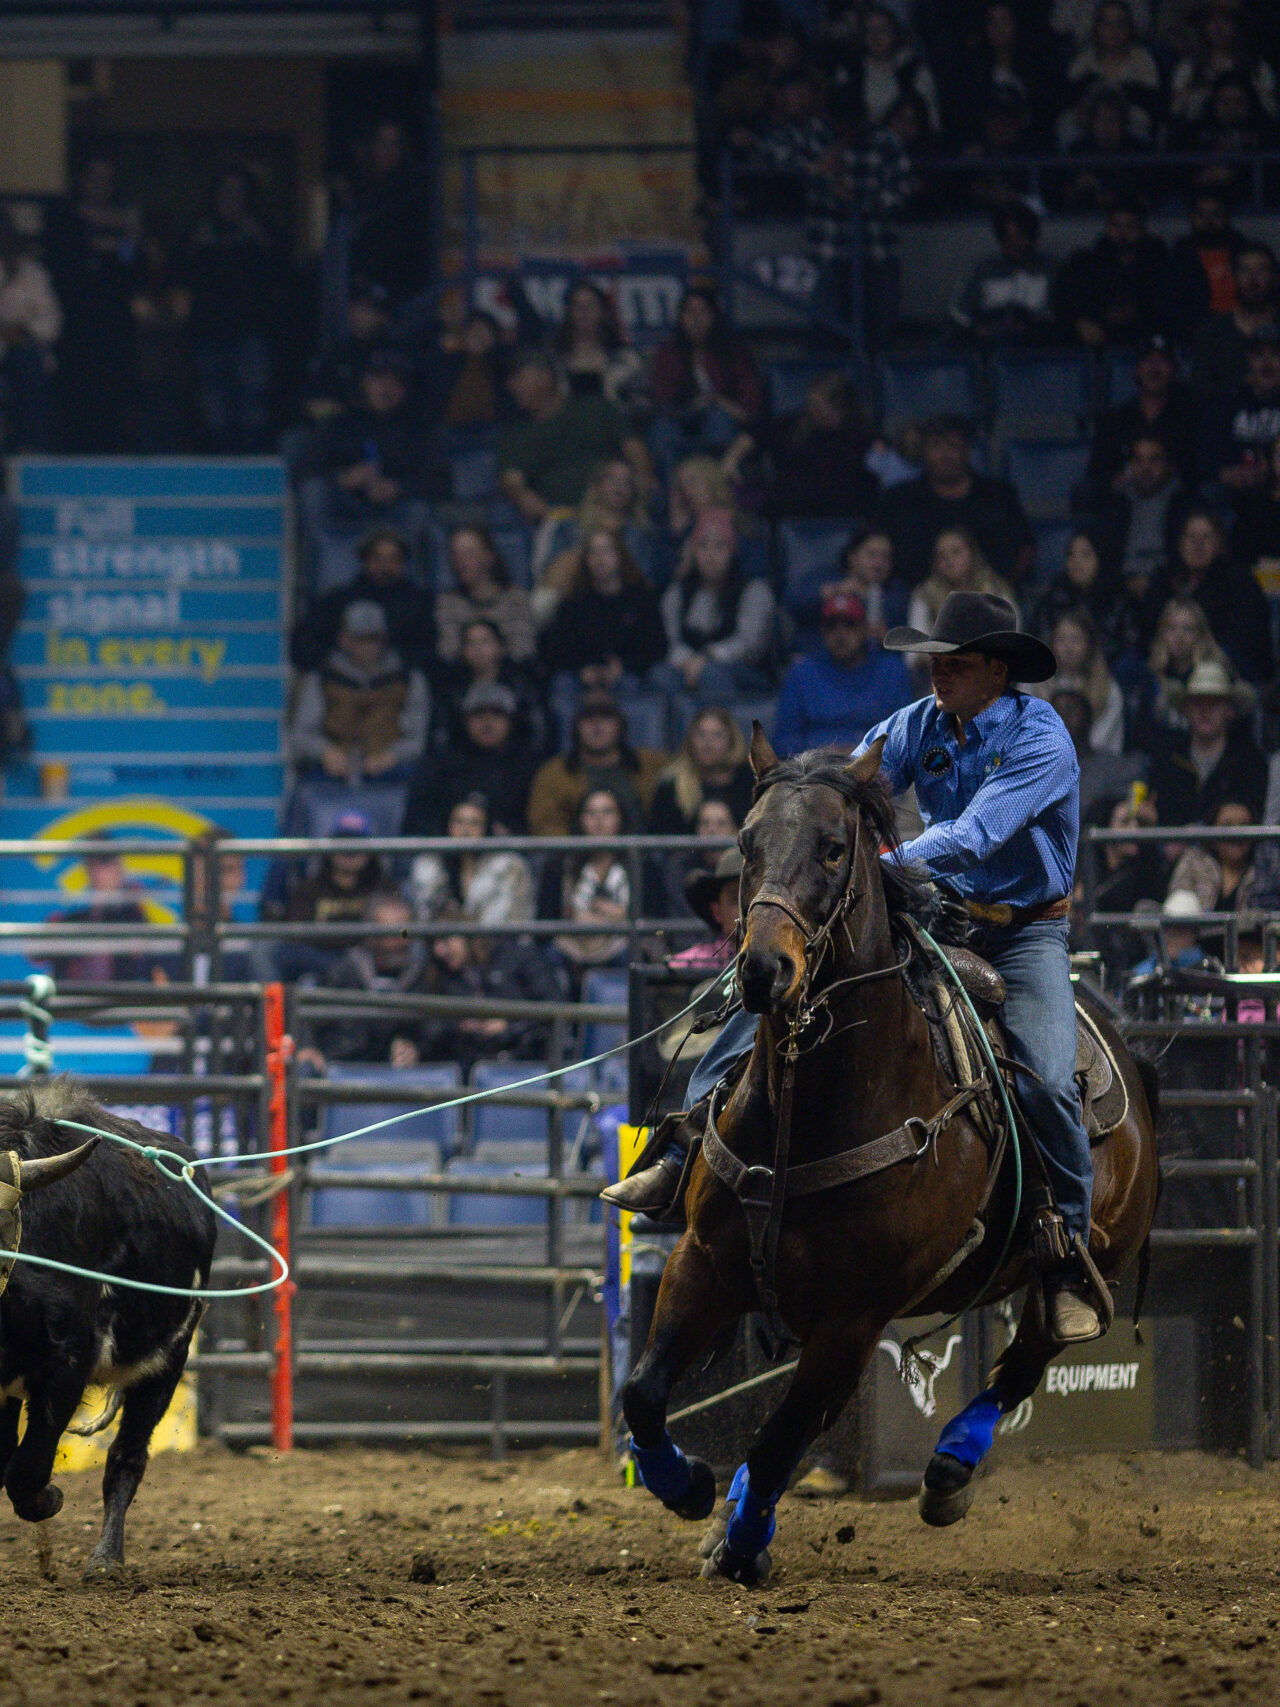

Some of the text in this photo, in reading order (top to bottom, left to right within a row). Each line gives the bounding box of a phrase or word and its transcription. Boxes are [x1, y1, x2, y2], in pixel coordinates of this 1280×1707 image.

[52, 542, 241, 585] strength
[48, 583, 182, 633] signal
[47, 629, 227, 684] in every
[49, 683, 167, 716] zone.
[1046, 1363, 1140, 1397] EQUIPMENT
